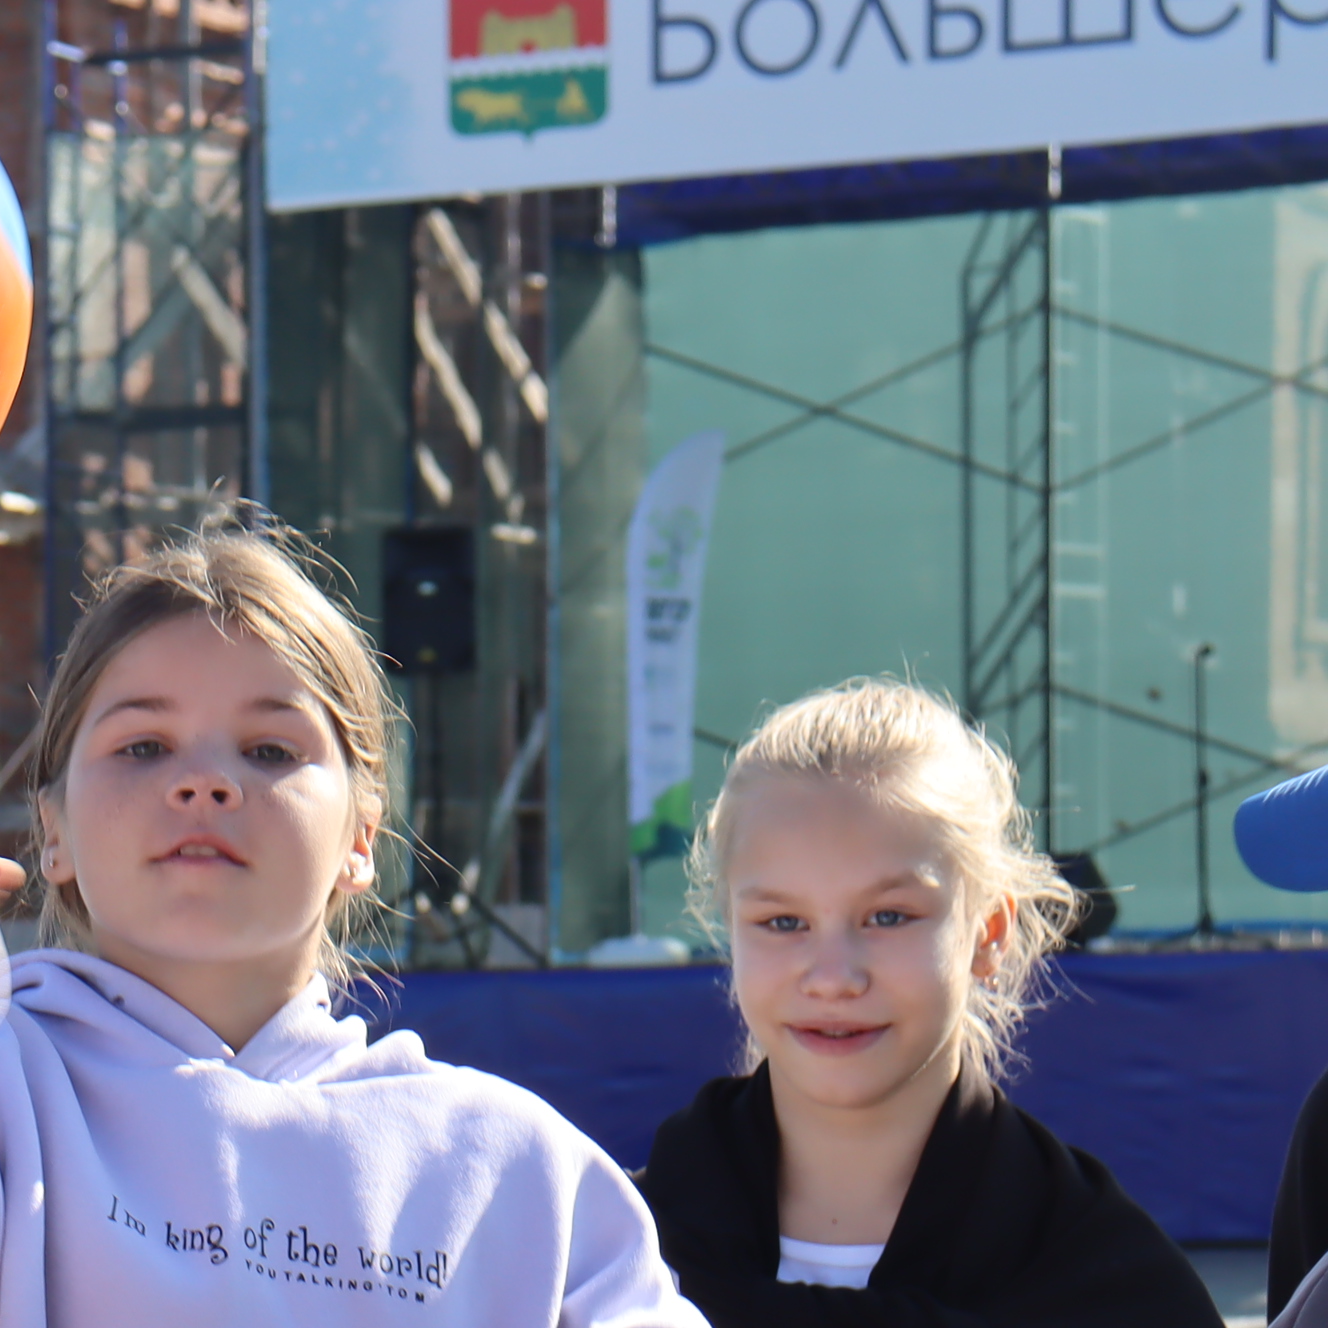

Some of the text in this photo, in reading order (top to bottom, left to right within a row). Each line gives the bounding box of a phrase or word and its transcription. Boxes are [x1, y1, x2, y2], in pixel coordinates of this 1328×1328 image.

[165, 1221, 229, 1265] king
[244, 1217, 275, 1258] of
[286, 1225, 339, 1268] the
